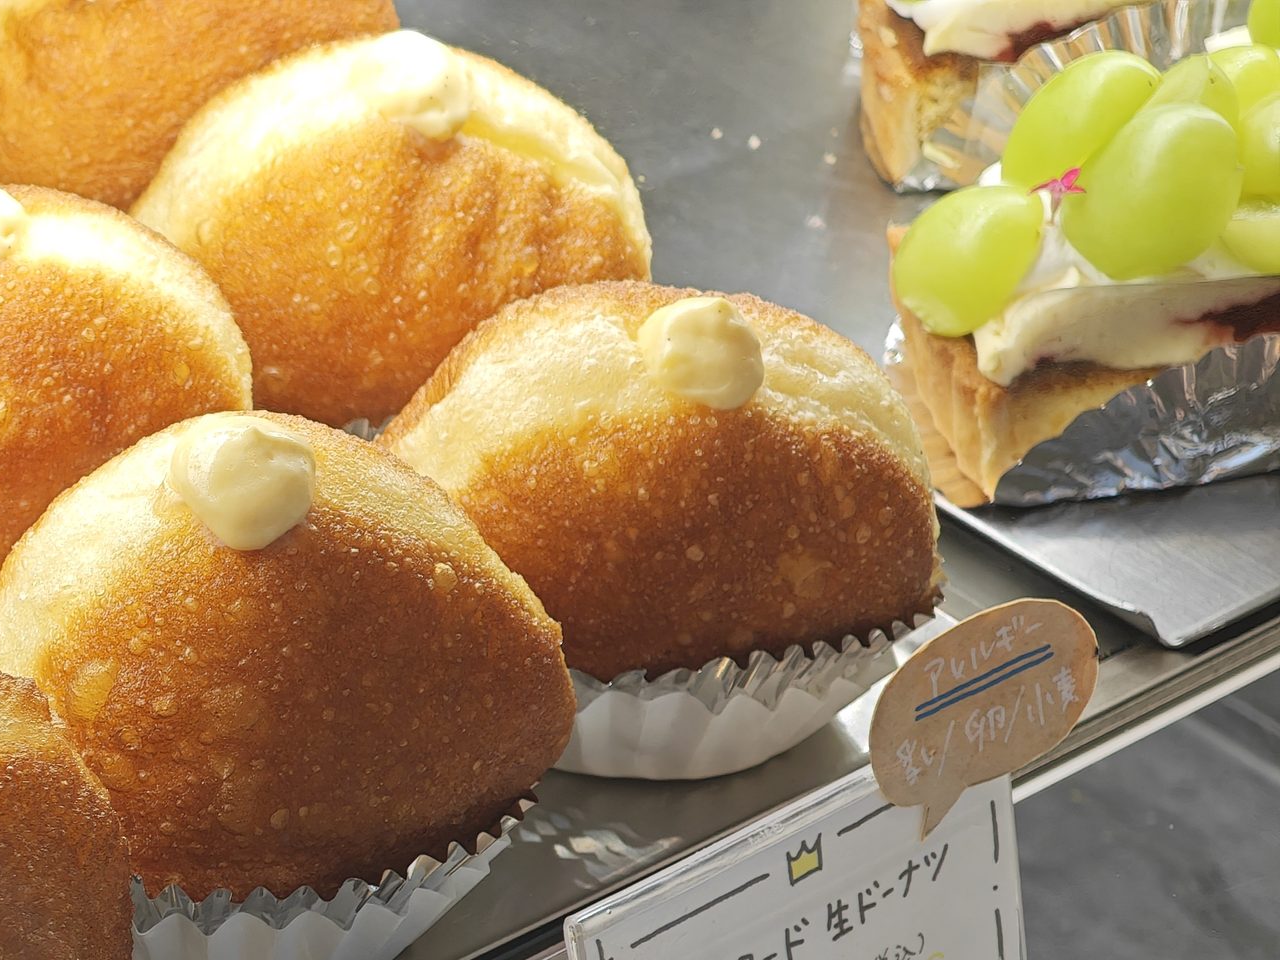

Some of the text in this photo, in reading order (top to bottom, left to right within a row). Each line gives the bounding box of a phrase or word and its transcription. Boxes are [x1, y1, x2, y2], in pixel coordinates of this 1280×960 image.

[826, 843, 949, 941] 生ドーナツ
